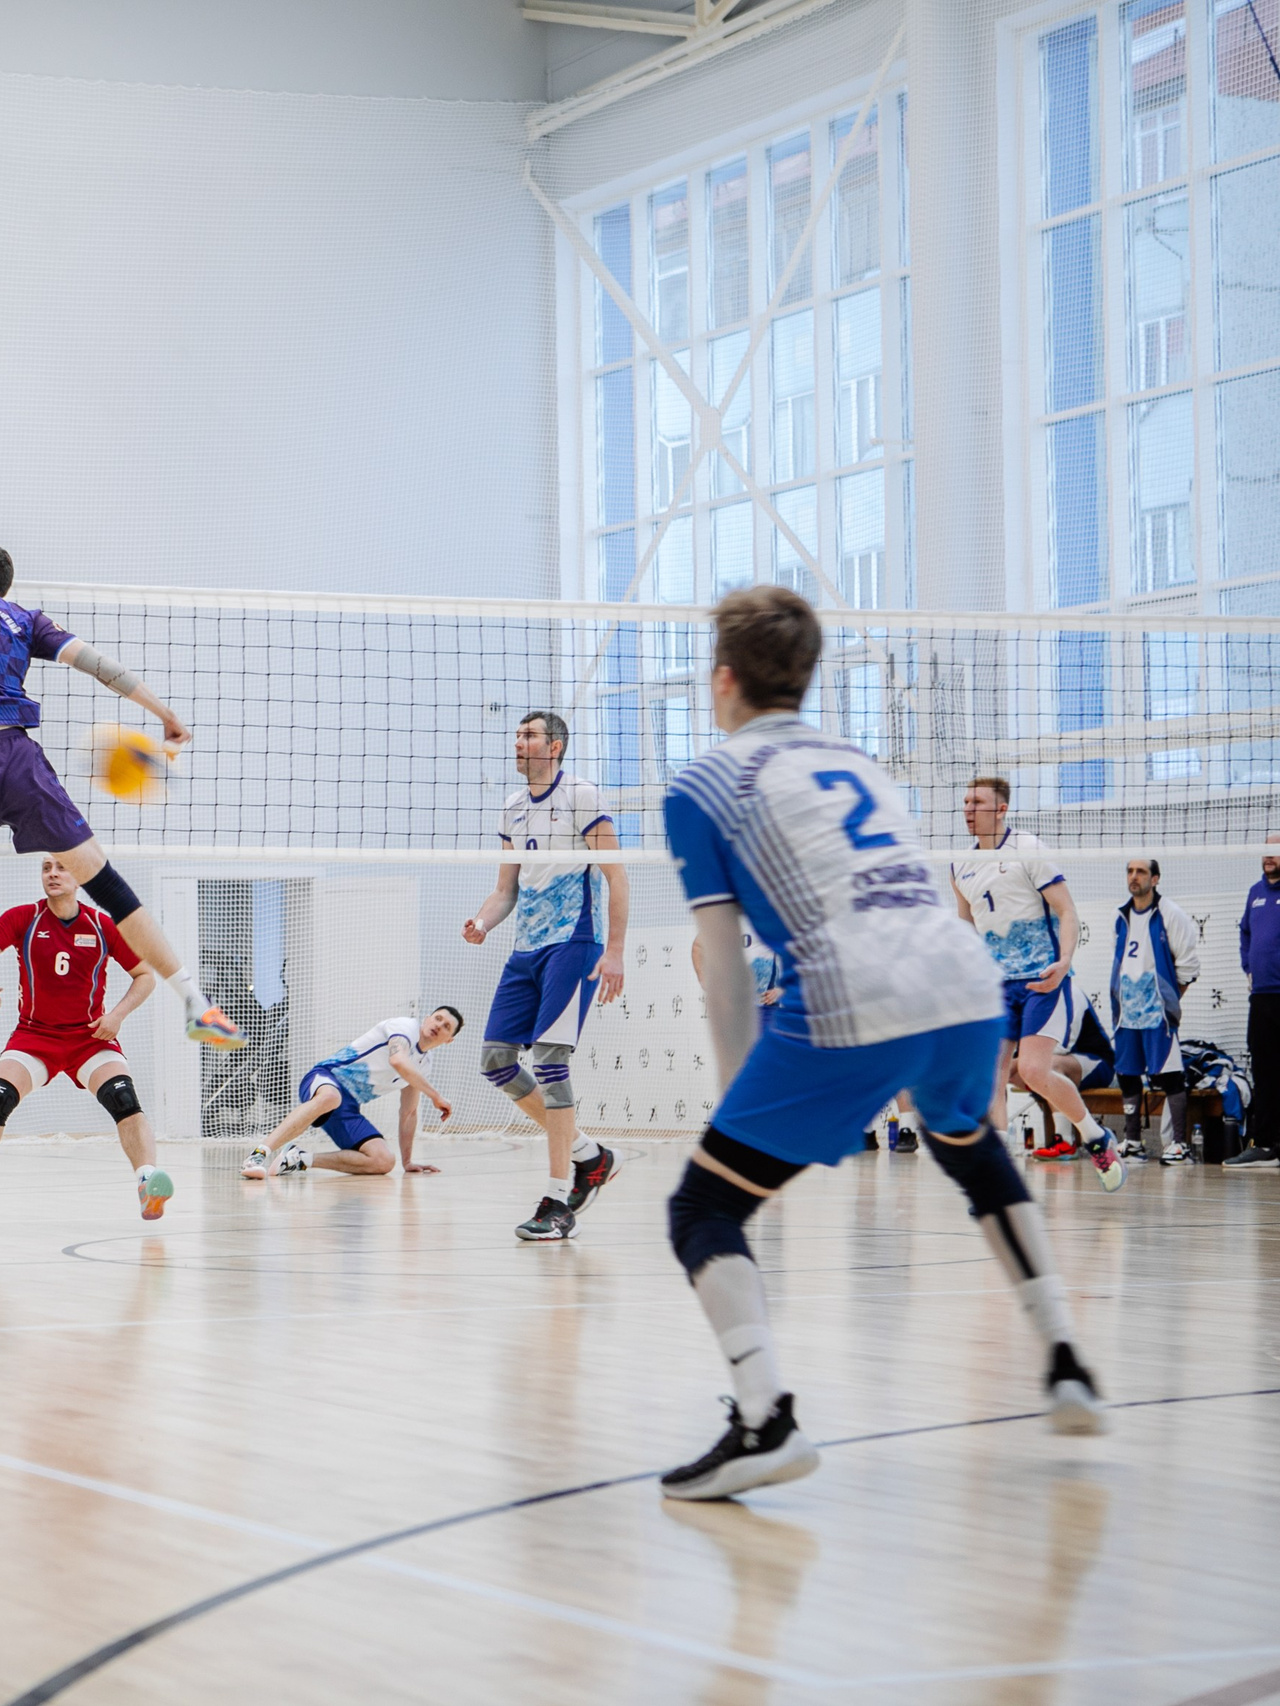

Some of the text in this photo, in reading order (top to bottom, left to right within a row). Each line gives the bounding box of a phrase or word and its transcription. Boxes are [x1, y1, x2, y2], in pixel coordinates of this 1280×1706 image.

[811, 770, 901, 851] 2
[982, 890, 995, 912] 1
[1128, 940, 1139, 958] 2
[54, 951, 71, 976] 6
